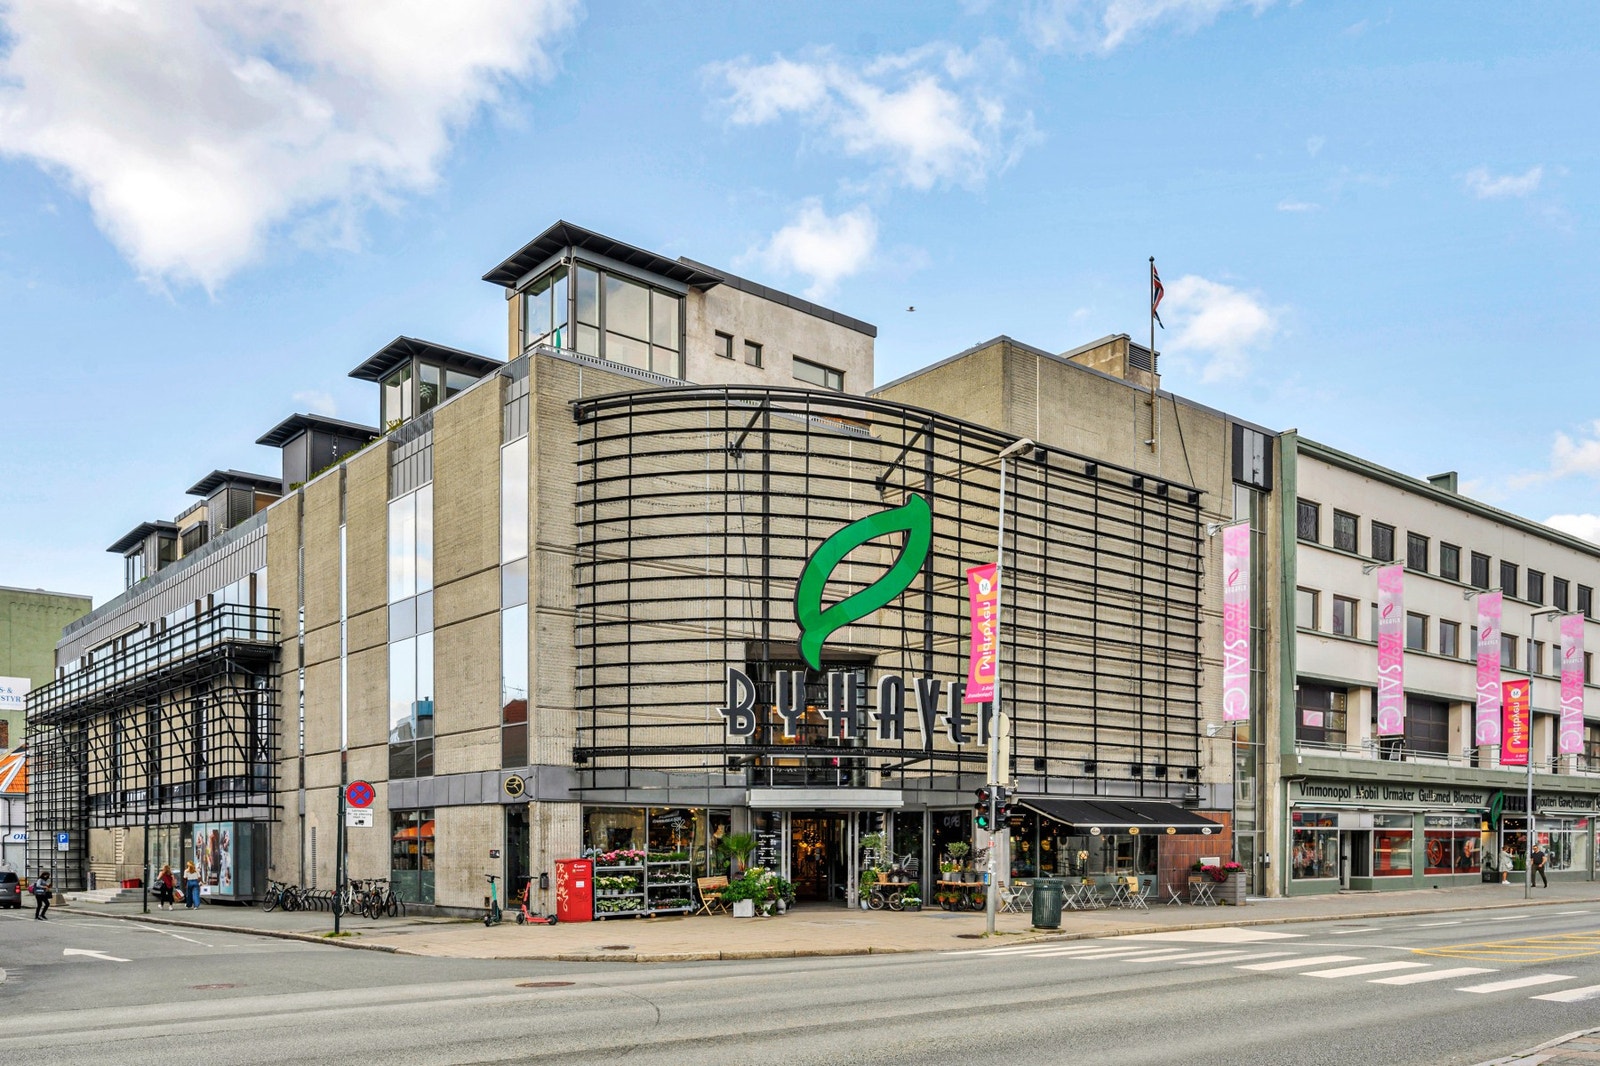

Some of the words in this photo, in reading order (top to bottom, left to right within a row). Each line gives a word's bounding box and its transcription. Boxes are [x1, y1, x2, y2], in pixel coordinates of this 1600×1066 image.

[1223, 639, 1247, 716] SALG
[1378, 664, 1401, 730] SALG
[1476, 682, 1498, 741] SALG
[1560, 696, 1582, 750] SALG
[1299, 781, 1351, 801] Vinmonopol
[1355, 785, 1379, 799] Mobil
[1383, 786, 1414, 801] Urmaker
[1453, 790, 1482, 804] Blomster
[59, 834, 66, 843] P
